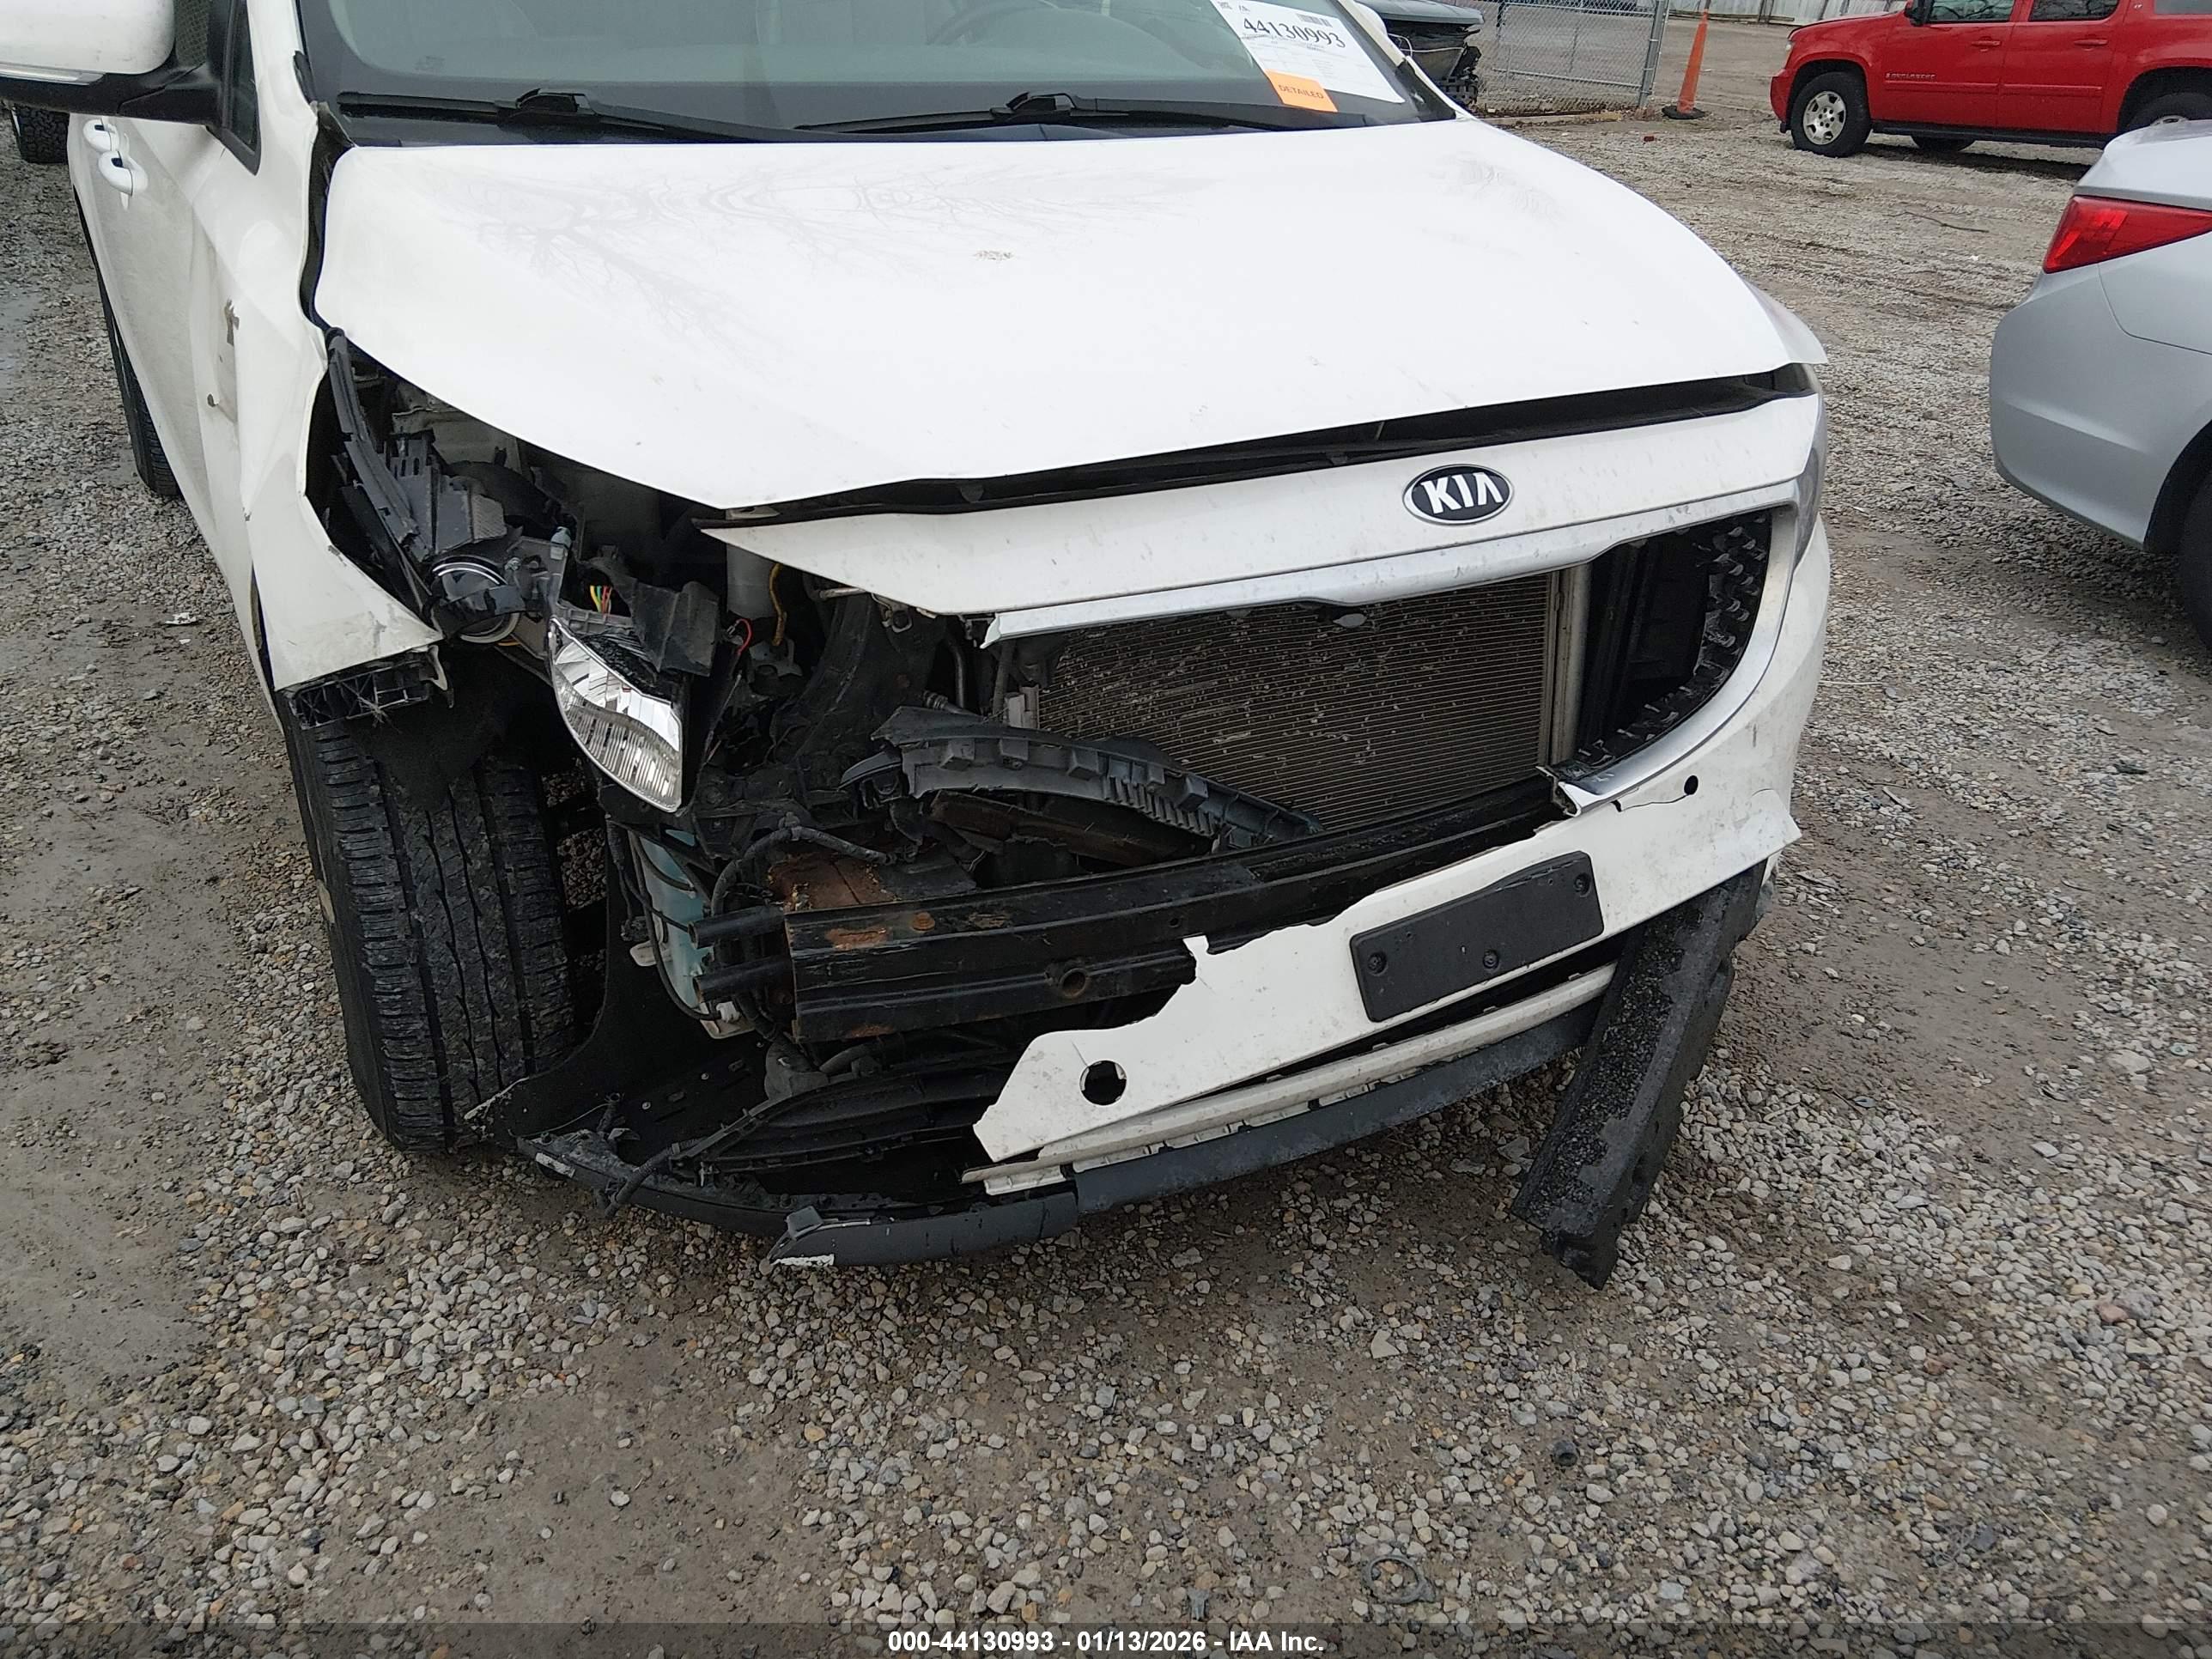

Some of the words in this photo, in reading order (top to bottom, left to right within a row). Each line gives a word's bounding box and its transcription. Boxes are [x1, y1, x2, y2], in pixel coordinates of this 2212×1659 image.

[1243, 17, 1346, 48] 44130993
[1278, 84, 1325, 99] DETAILED
[1419, 471, 1504, 514] KIA
